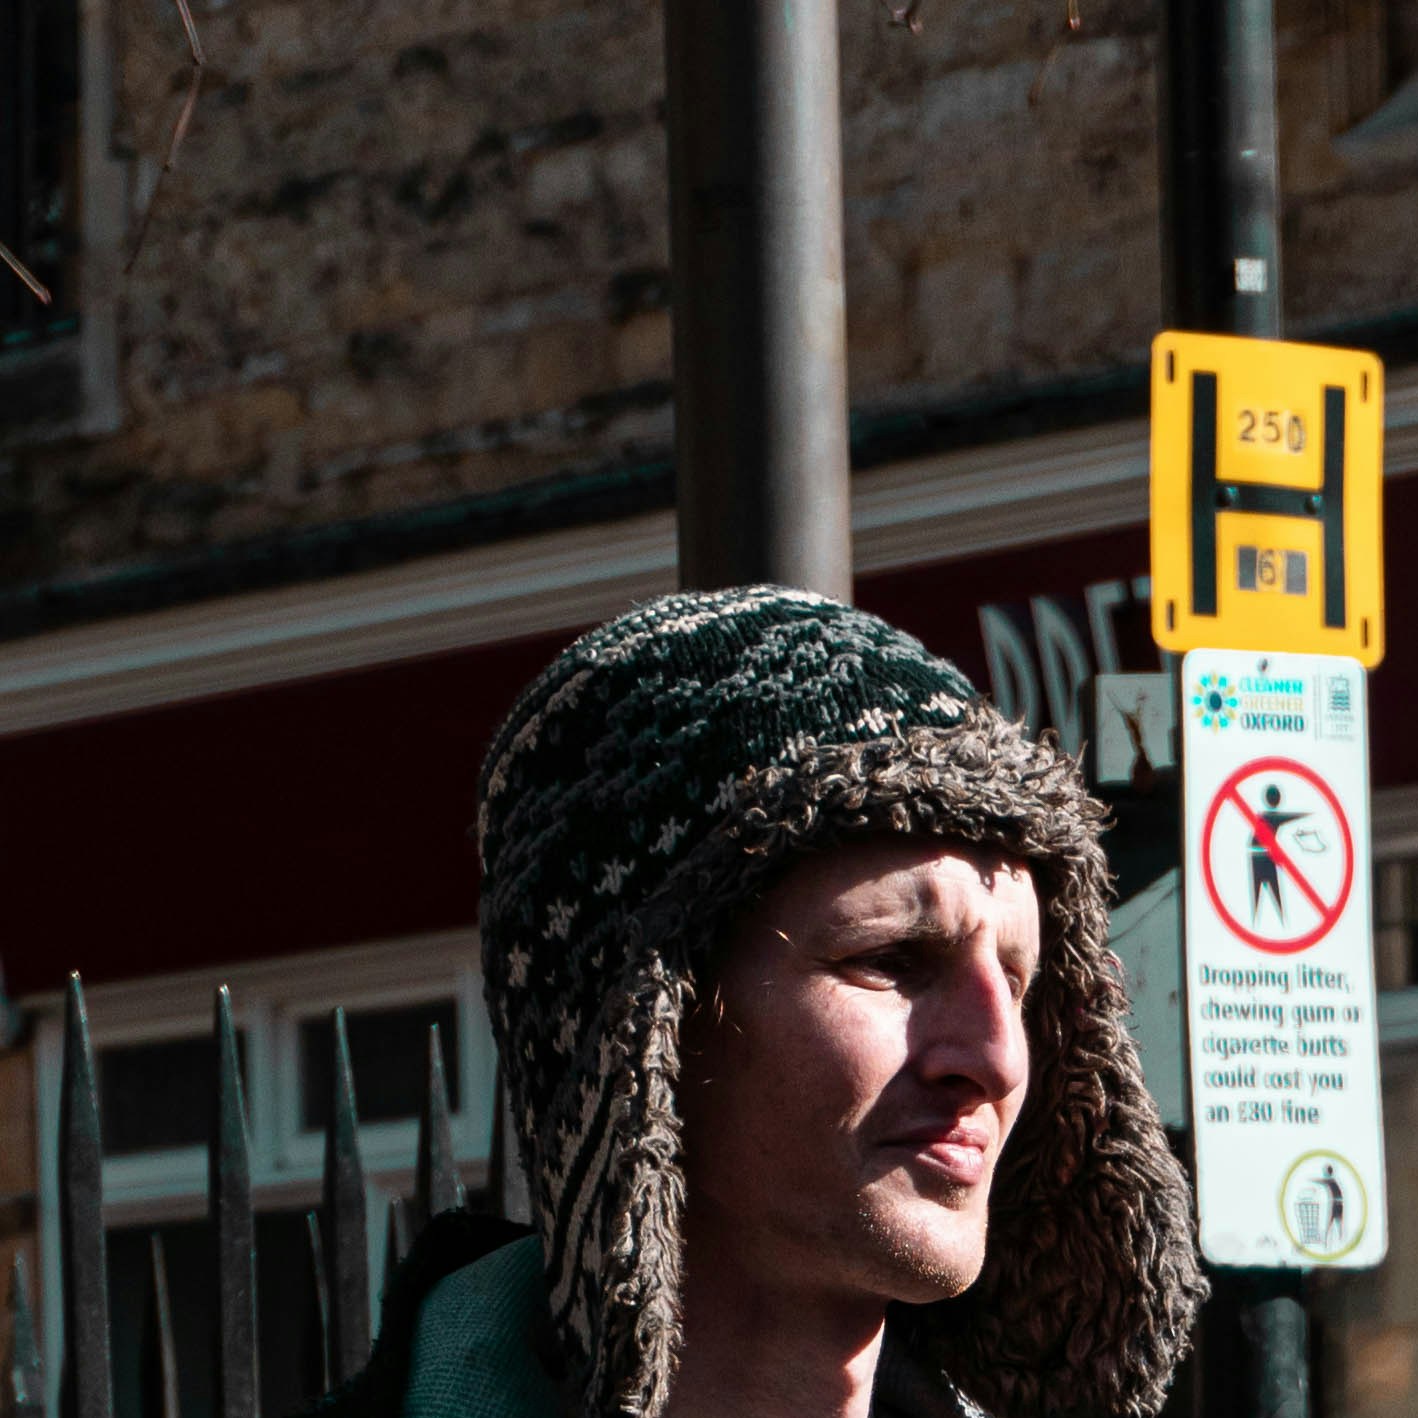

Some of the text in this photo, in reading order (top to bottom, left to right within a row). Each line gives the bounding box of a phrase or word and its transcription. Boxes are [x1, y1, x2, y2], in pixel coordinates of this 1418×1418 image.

[1237, 409, 1305, 453] 250
[1240, 677, 1303, 695] CLEANER
[1240, 712, 1304, 732] OXFORD
[1199, 963, 1351, 994] Dropping litter,
[1201, 996, 1361, 1029] chewing gum or
[1202, 1030, 1348, 1060] cigarette butts
[1204, 1065, 1345, 1096] could cost you
[1206, 1104, 1230, 1123] an
[1281, 1099, 1320, 1124] fine
